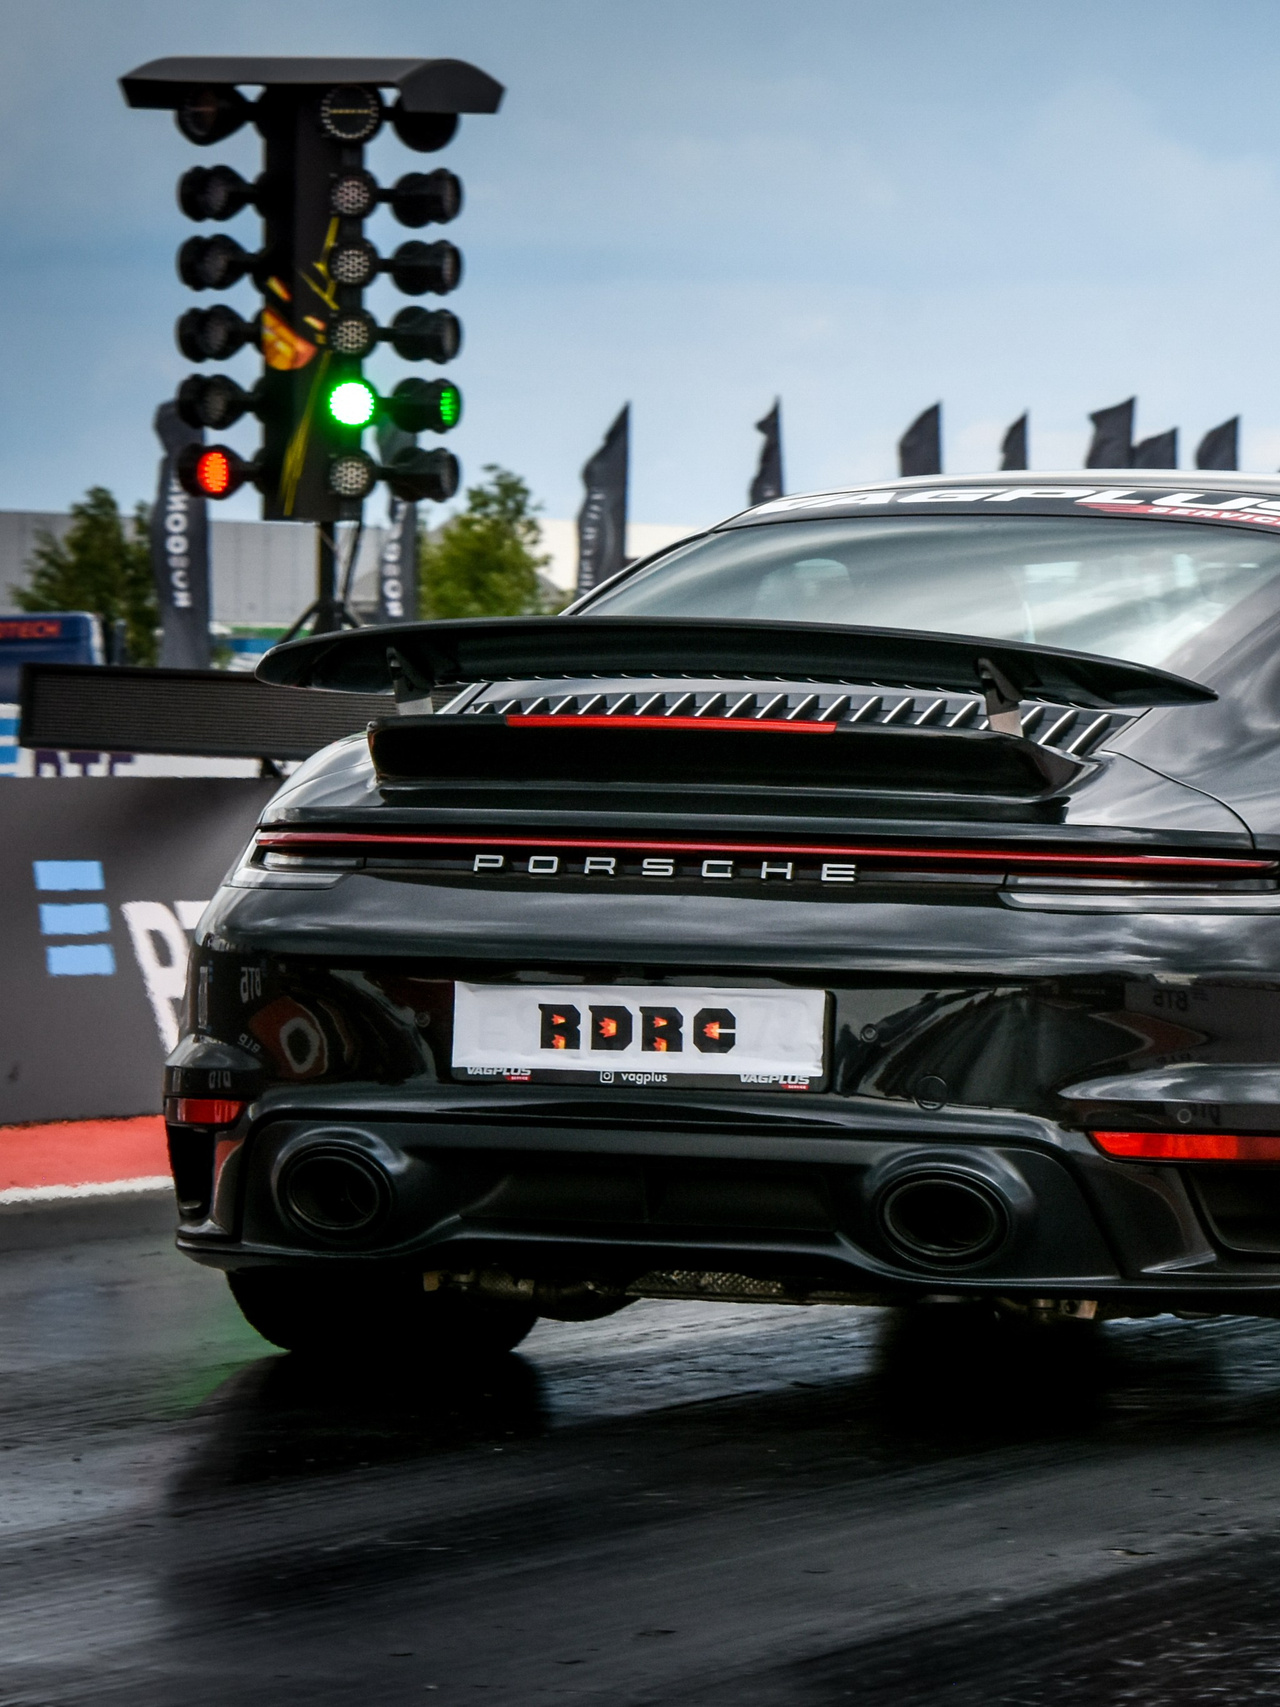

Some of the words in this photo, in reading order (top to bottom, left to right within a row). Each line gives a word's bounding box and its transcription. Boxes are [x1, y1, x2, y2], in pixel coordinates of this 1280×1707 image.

[473, 854, 856, 882] PORSCHE
[538, 1003, 737, 1054] RDRC
[467, 1067, 532, 1076] VAGPLUS
[621, 1071, 668, 1085] vagplus
[740, 1073, 810, 1085] VAGPLUS
